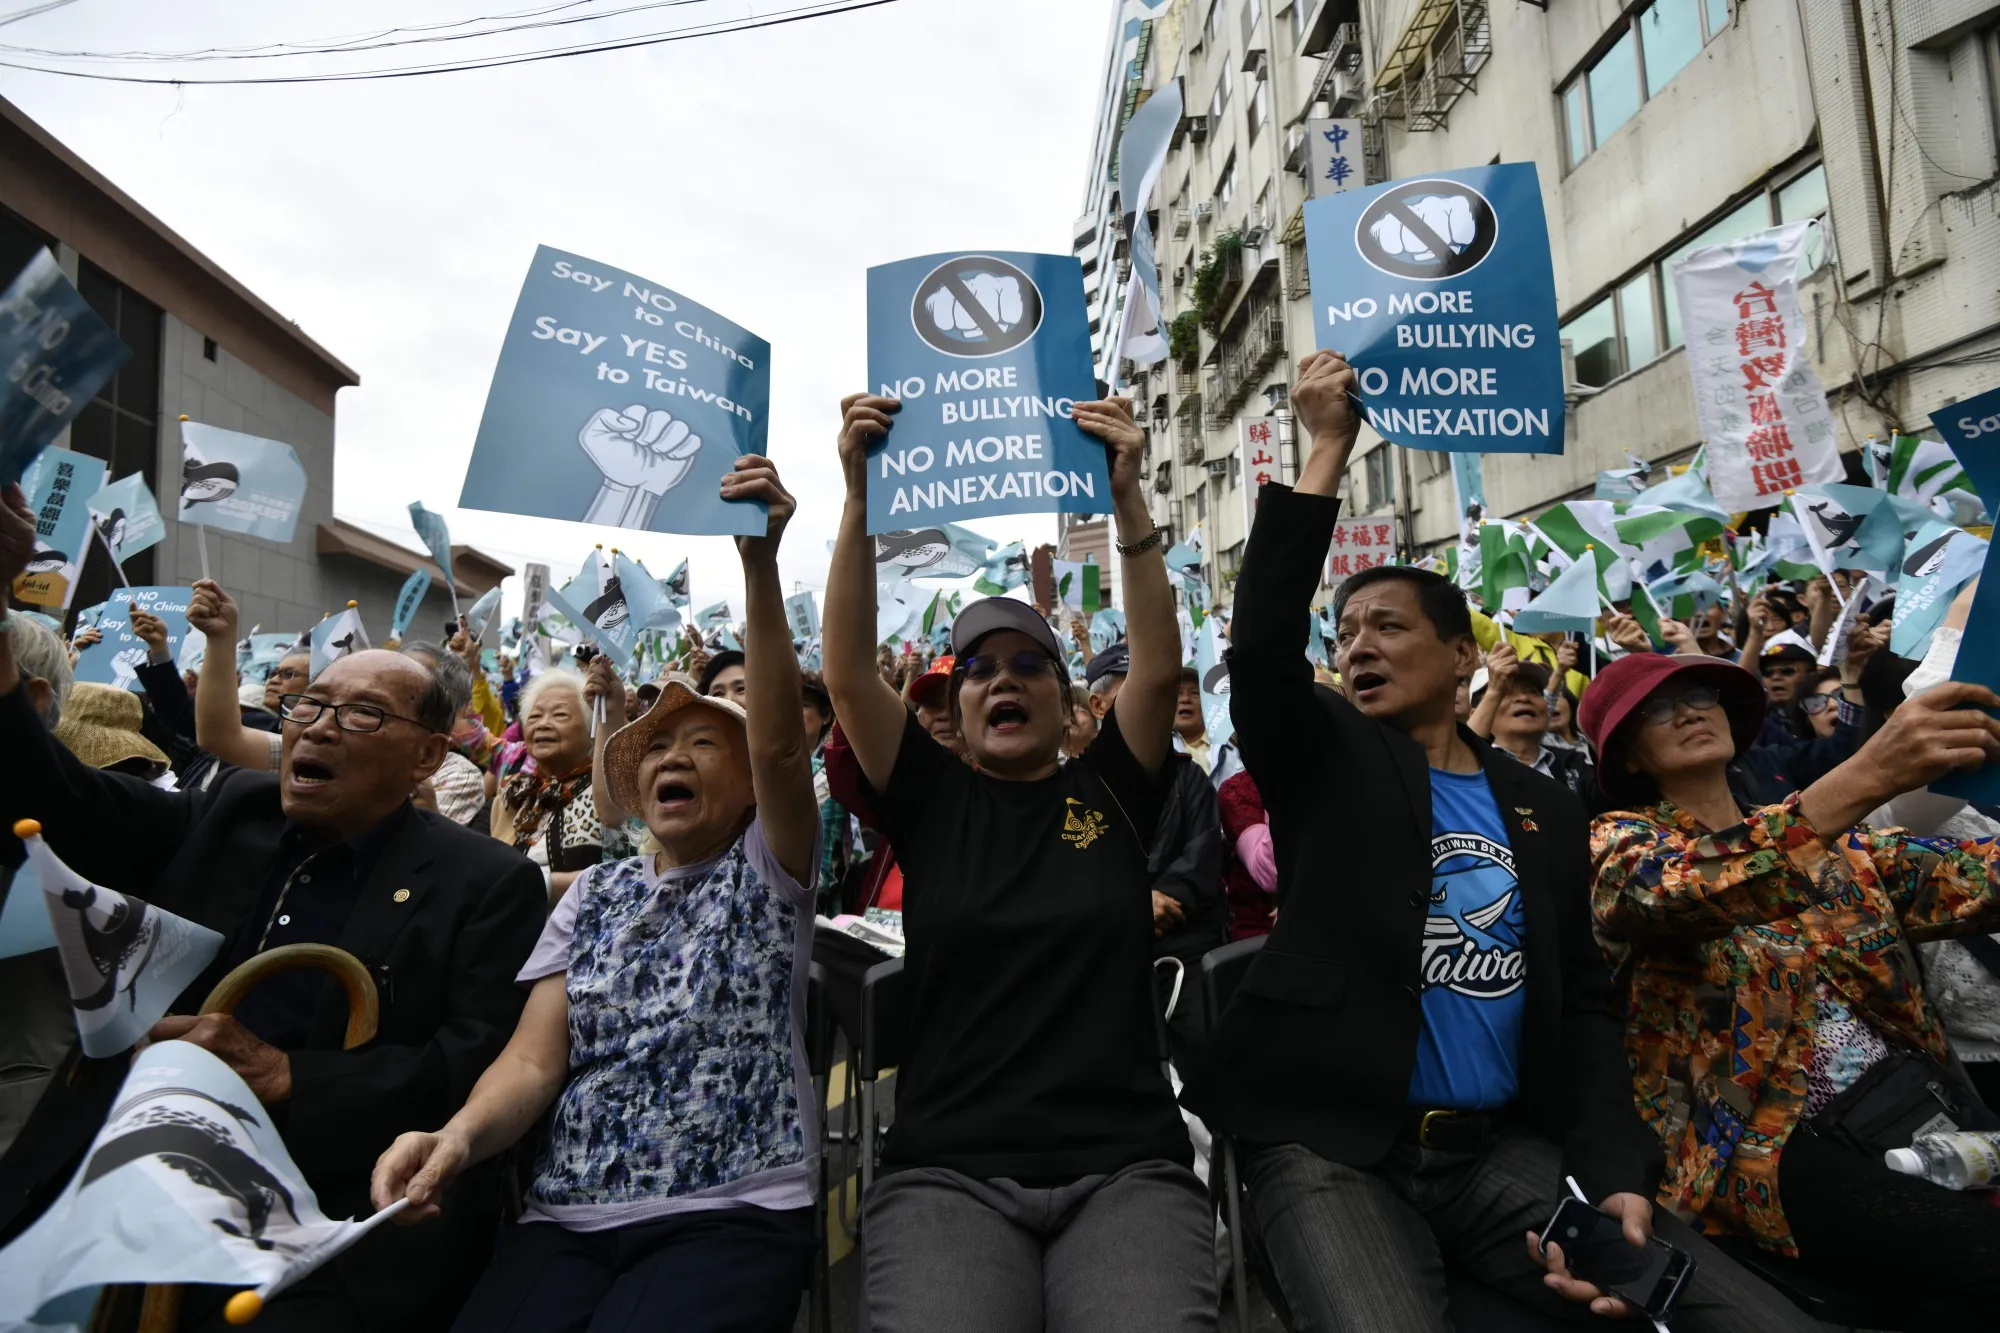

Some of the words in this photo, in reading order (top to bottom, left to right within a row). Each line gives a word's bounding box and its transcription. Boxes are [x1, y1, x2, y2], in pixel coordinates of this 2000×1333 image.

[1323, 124, 1354, 194] 中華
[552, 261, 613, 293] Say
[623, 282, 677, 313] NO
[1328, 298, 1377, 326] NO
[1388, 290, 1473, 315] MORE
[532, 316, 607, 354] Say
[621, 333, 688, 370] YES
[635, 305, 664, 326] to
[675, 321, 754, 371] China
[1396, 323, 1536, 348] BULLYING
[597, 361, 629, 384] to
[642, 368, 753, 422] Taiwan
[881, 377, 925, 401] NO
[935, 367, 1017, 395] MORE
[1400, 367, 1497, 396] MORE
[942, 396, 1075, 424] BULLYING
[1367, 408, 1549, 437] NNEXATION
[881, 447, 934, 479] NO
[945, 434, 1042, 468] MORE
[889, 471, 1095, 516] ANNEXATION
[1332, 524, 1391, 549] 幸福里
[137, 591, 158, 600] NO
[138, 602, 149, 611] to
[153, 601, 187, 612] China
[101, 618, 126, 631] Say
[120, 632, 132, 642] to
[1480, 842, 1496, 855] BE
